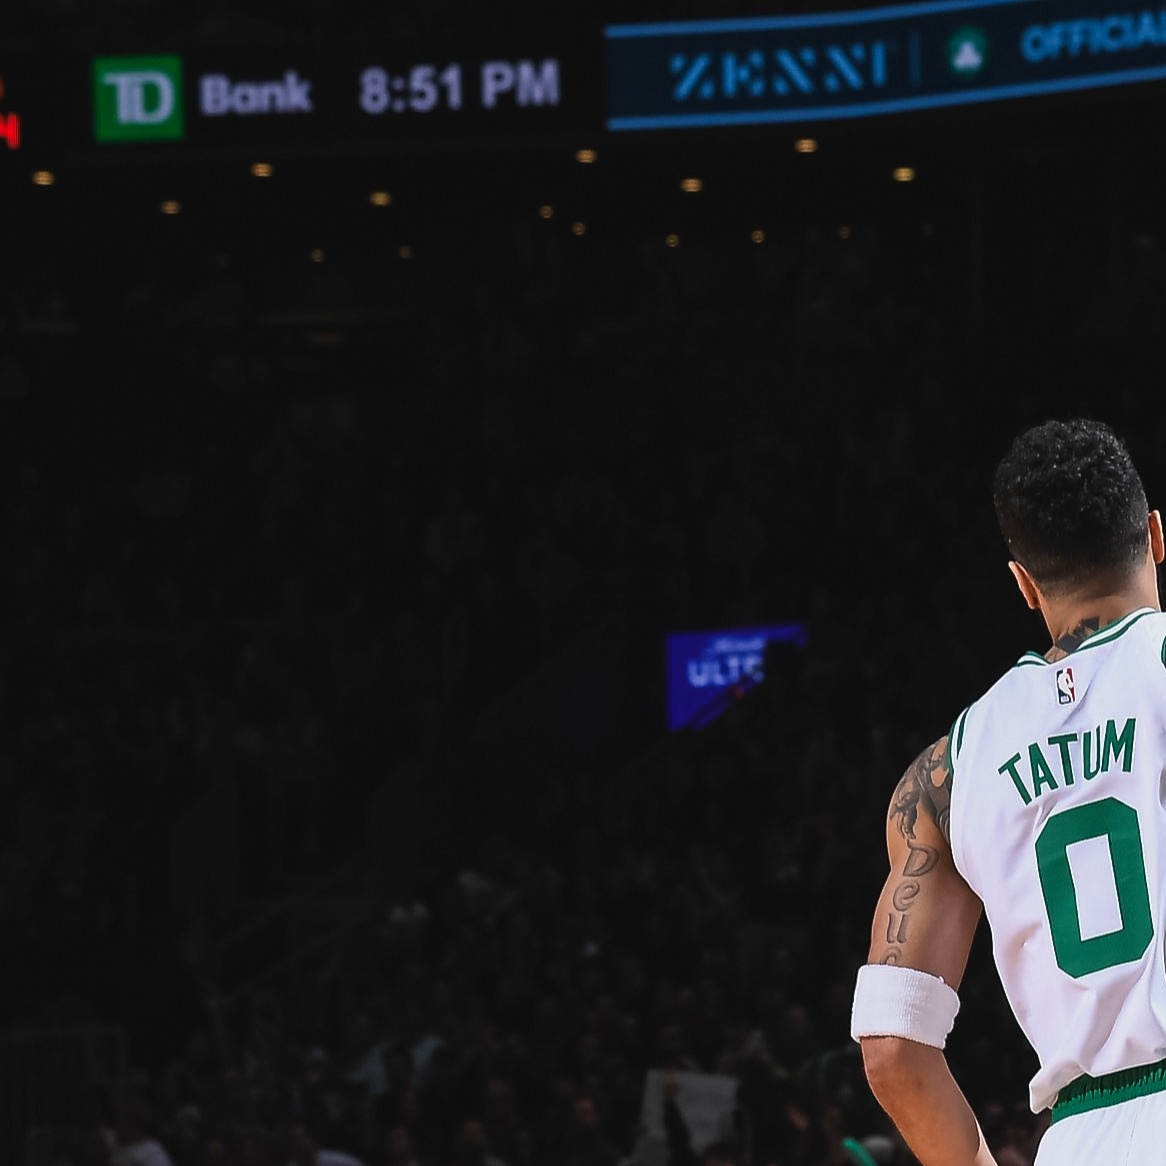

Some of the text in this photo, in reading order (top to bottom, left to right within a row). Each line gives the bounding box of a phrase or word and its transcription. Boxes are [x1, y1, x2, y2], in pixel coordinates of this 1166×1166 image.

[102, 71, 312, 125] TD Bank
[360, 59, 560, 115] 8:51 PM
[668, 41, 888, 100] ZENNI
[998, 717, 1137, 806] TATUM
[1034, 796, 1155, 980] 0
